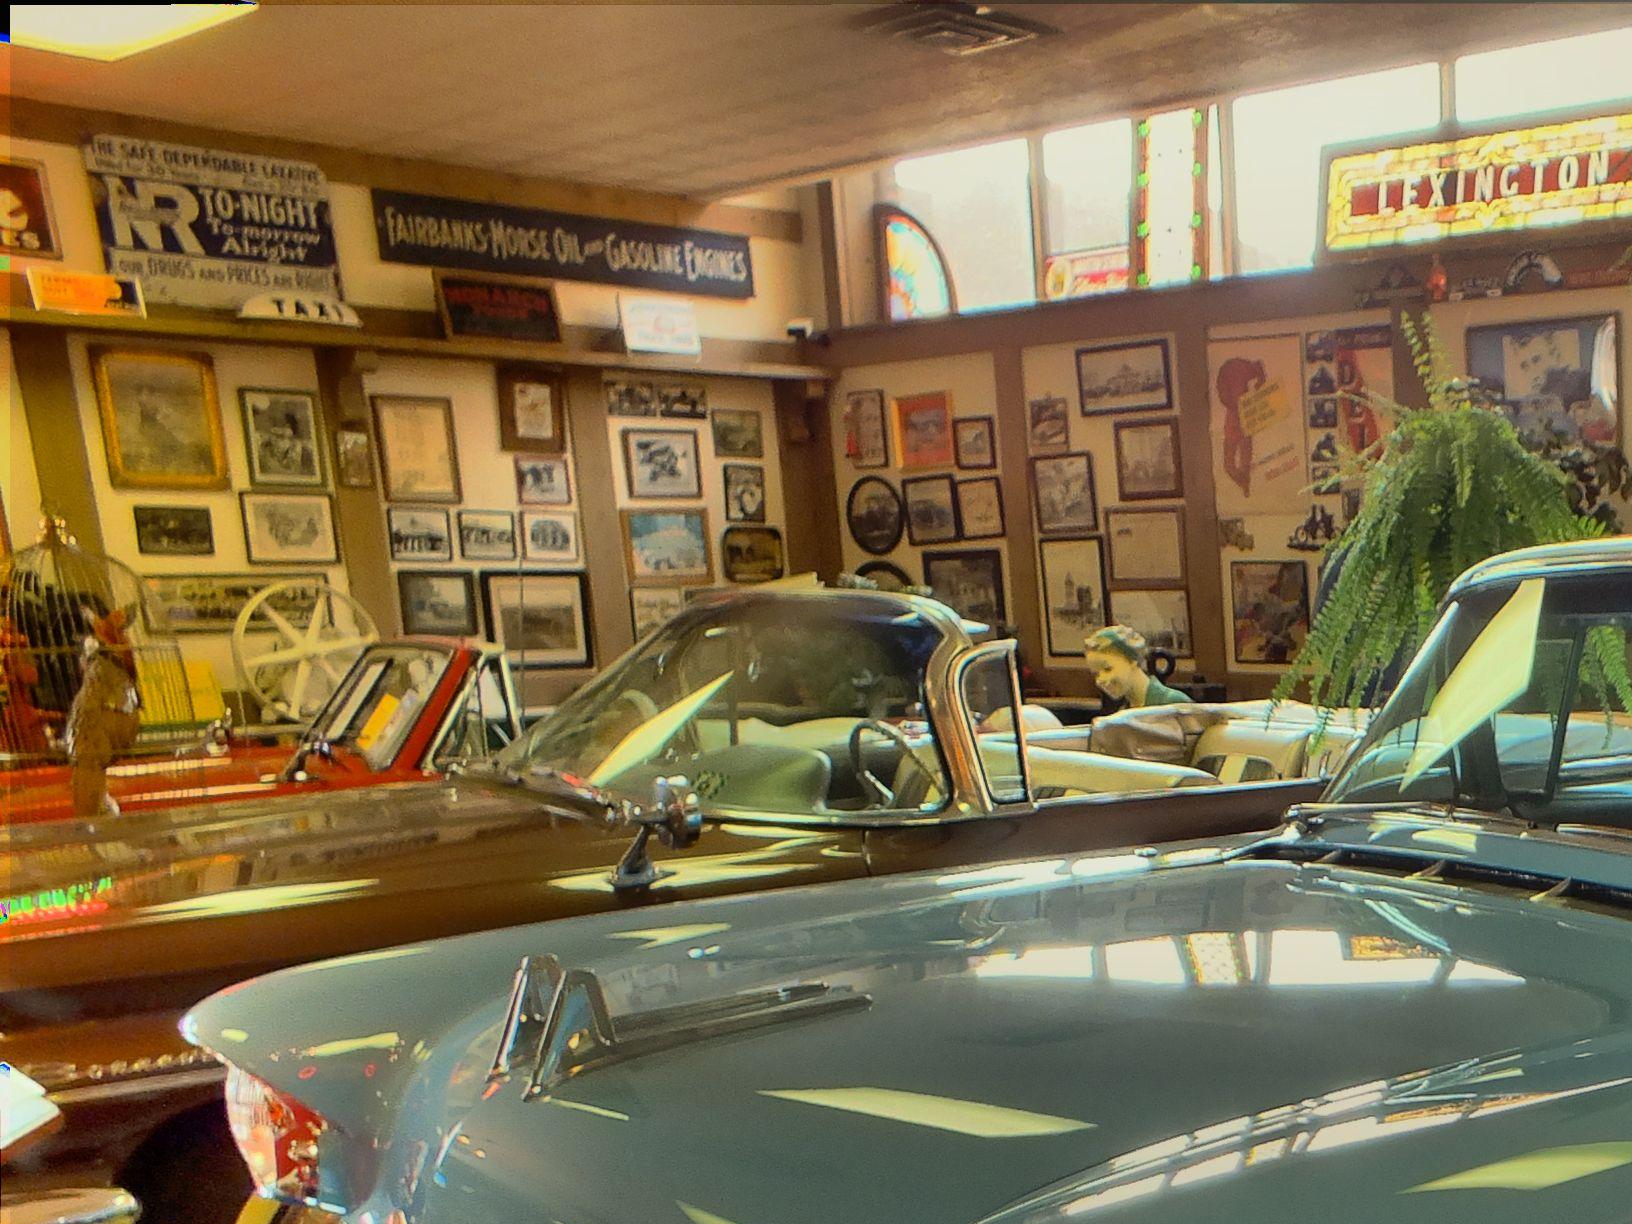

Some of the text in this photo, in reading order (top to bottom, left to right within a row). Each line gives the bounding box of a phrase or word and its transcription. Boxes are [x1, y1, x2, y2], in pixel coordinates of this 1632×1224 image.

[1376, 150, 1610, 215] LEXINGTON
[199, 187, 321, 231] TO-NIGHT
[553, 228, 584, 265] OIL
[604, 233, 683, 275] GASOLINE
[683, 241, 748, 282] ENGINES
[271, 298, 344, 322] TAXI
